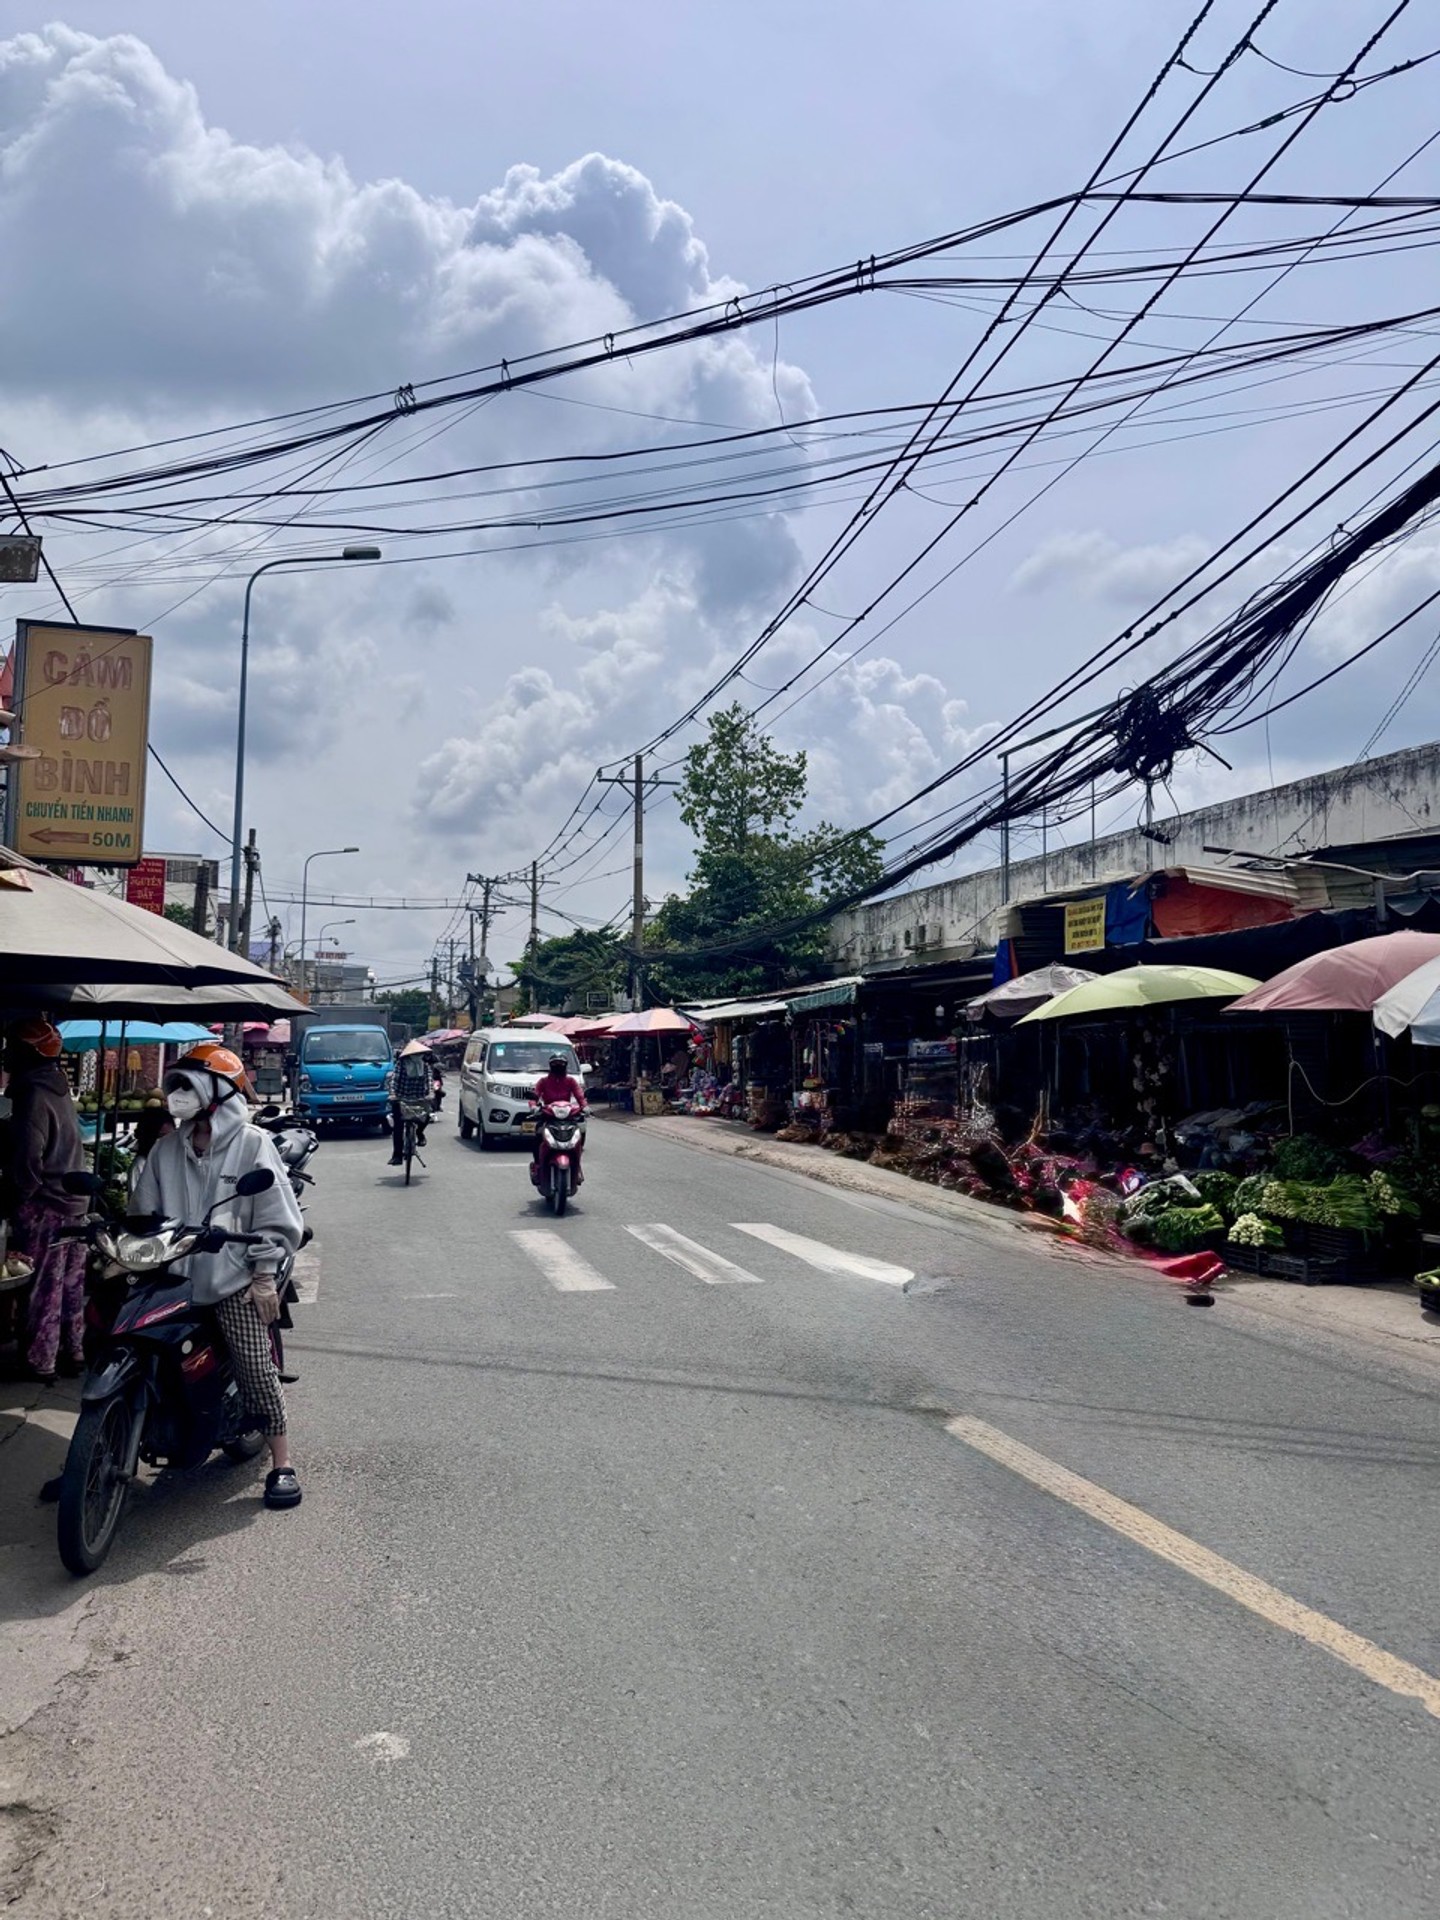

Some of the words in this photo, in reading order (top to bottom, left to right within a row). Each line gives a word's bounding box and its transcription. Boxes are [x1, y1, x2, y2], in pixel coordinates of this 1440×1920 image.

[33, 750, 130, 796] BÌNH
[26, 797, 67, 818] CHUYỂN
[97, 806, 134, 823] NHANH
[92, 832, 131, 848] 50M
